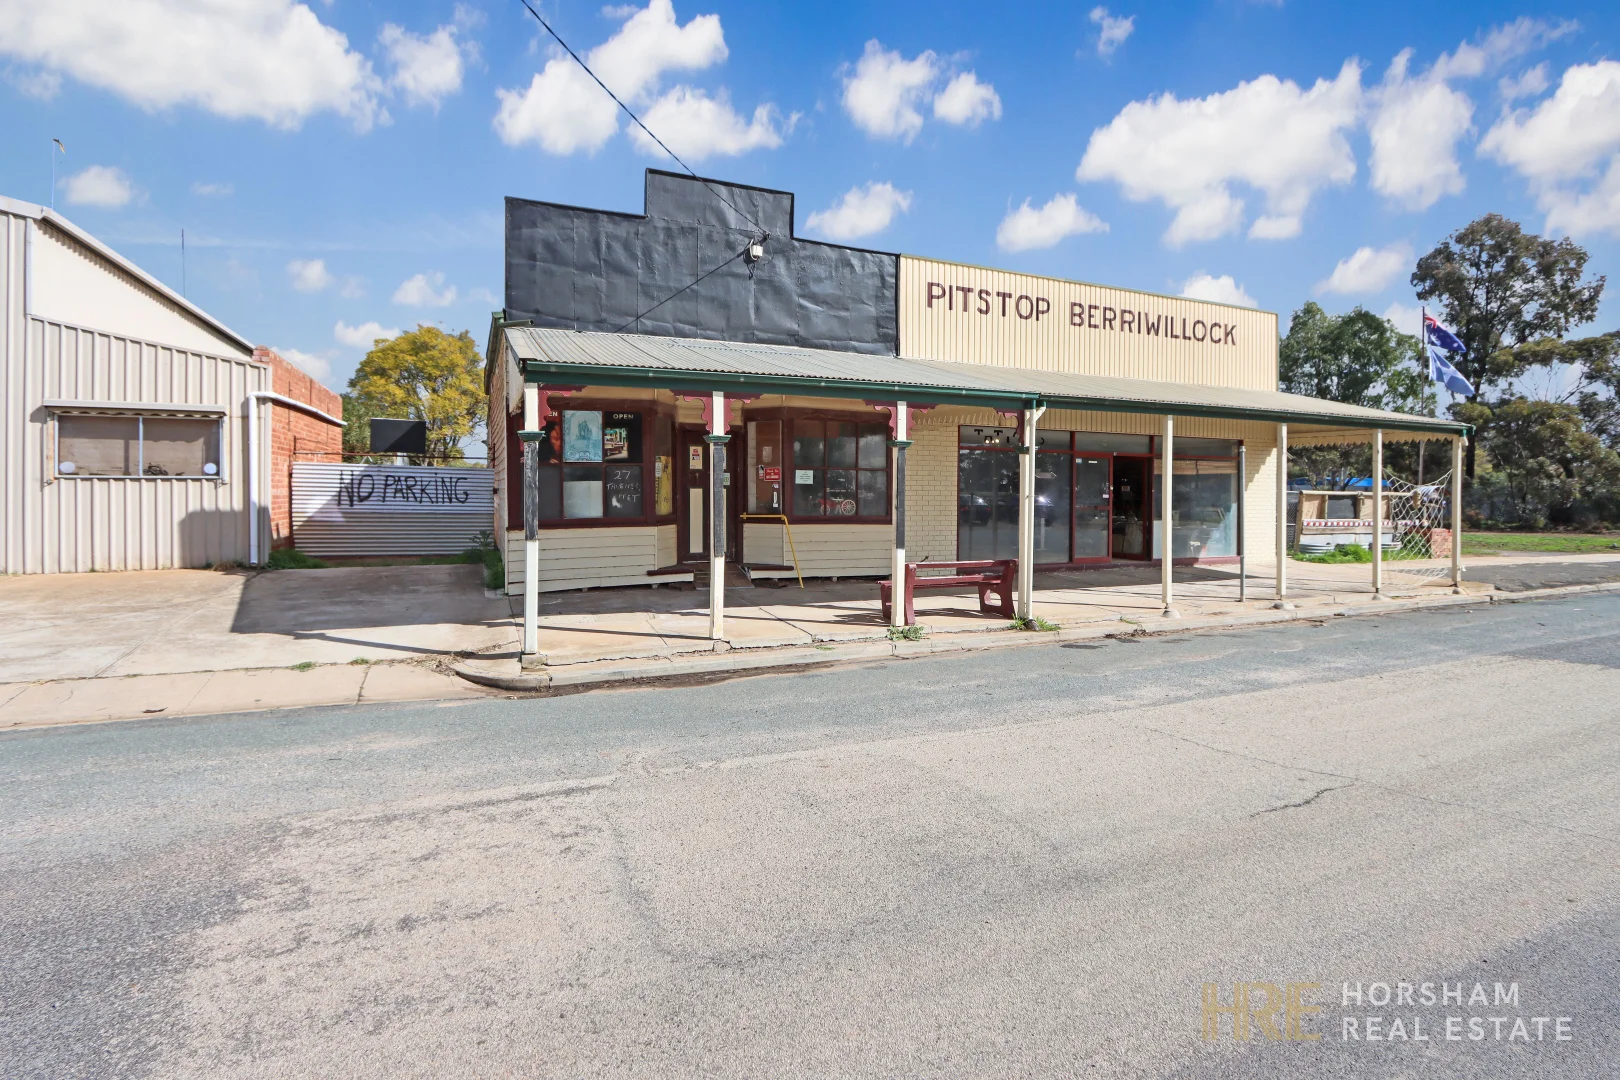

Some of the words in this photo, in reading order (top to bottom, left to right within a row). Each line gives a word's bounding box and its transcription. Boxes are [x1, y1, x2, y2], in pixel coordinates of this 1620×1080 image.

[926, 281, 1051, 322] PITSTOP
[1069, 301, 1237, 346] BERRIWILLOCK
[337, 470, 375, 507] NO
[613, 470, 631, 480] 27
